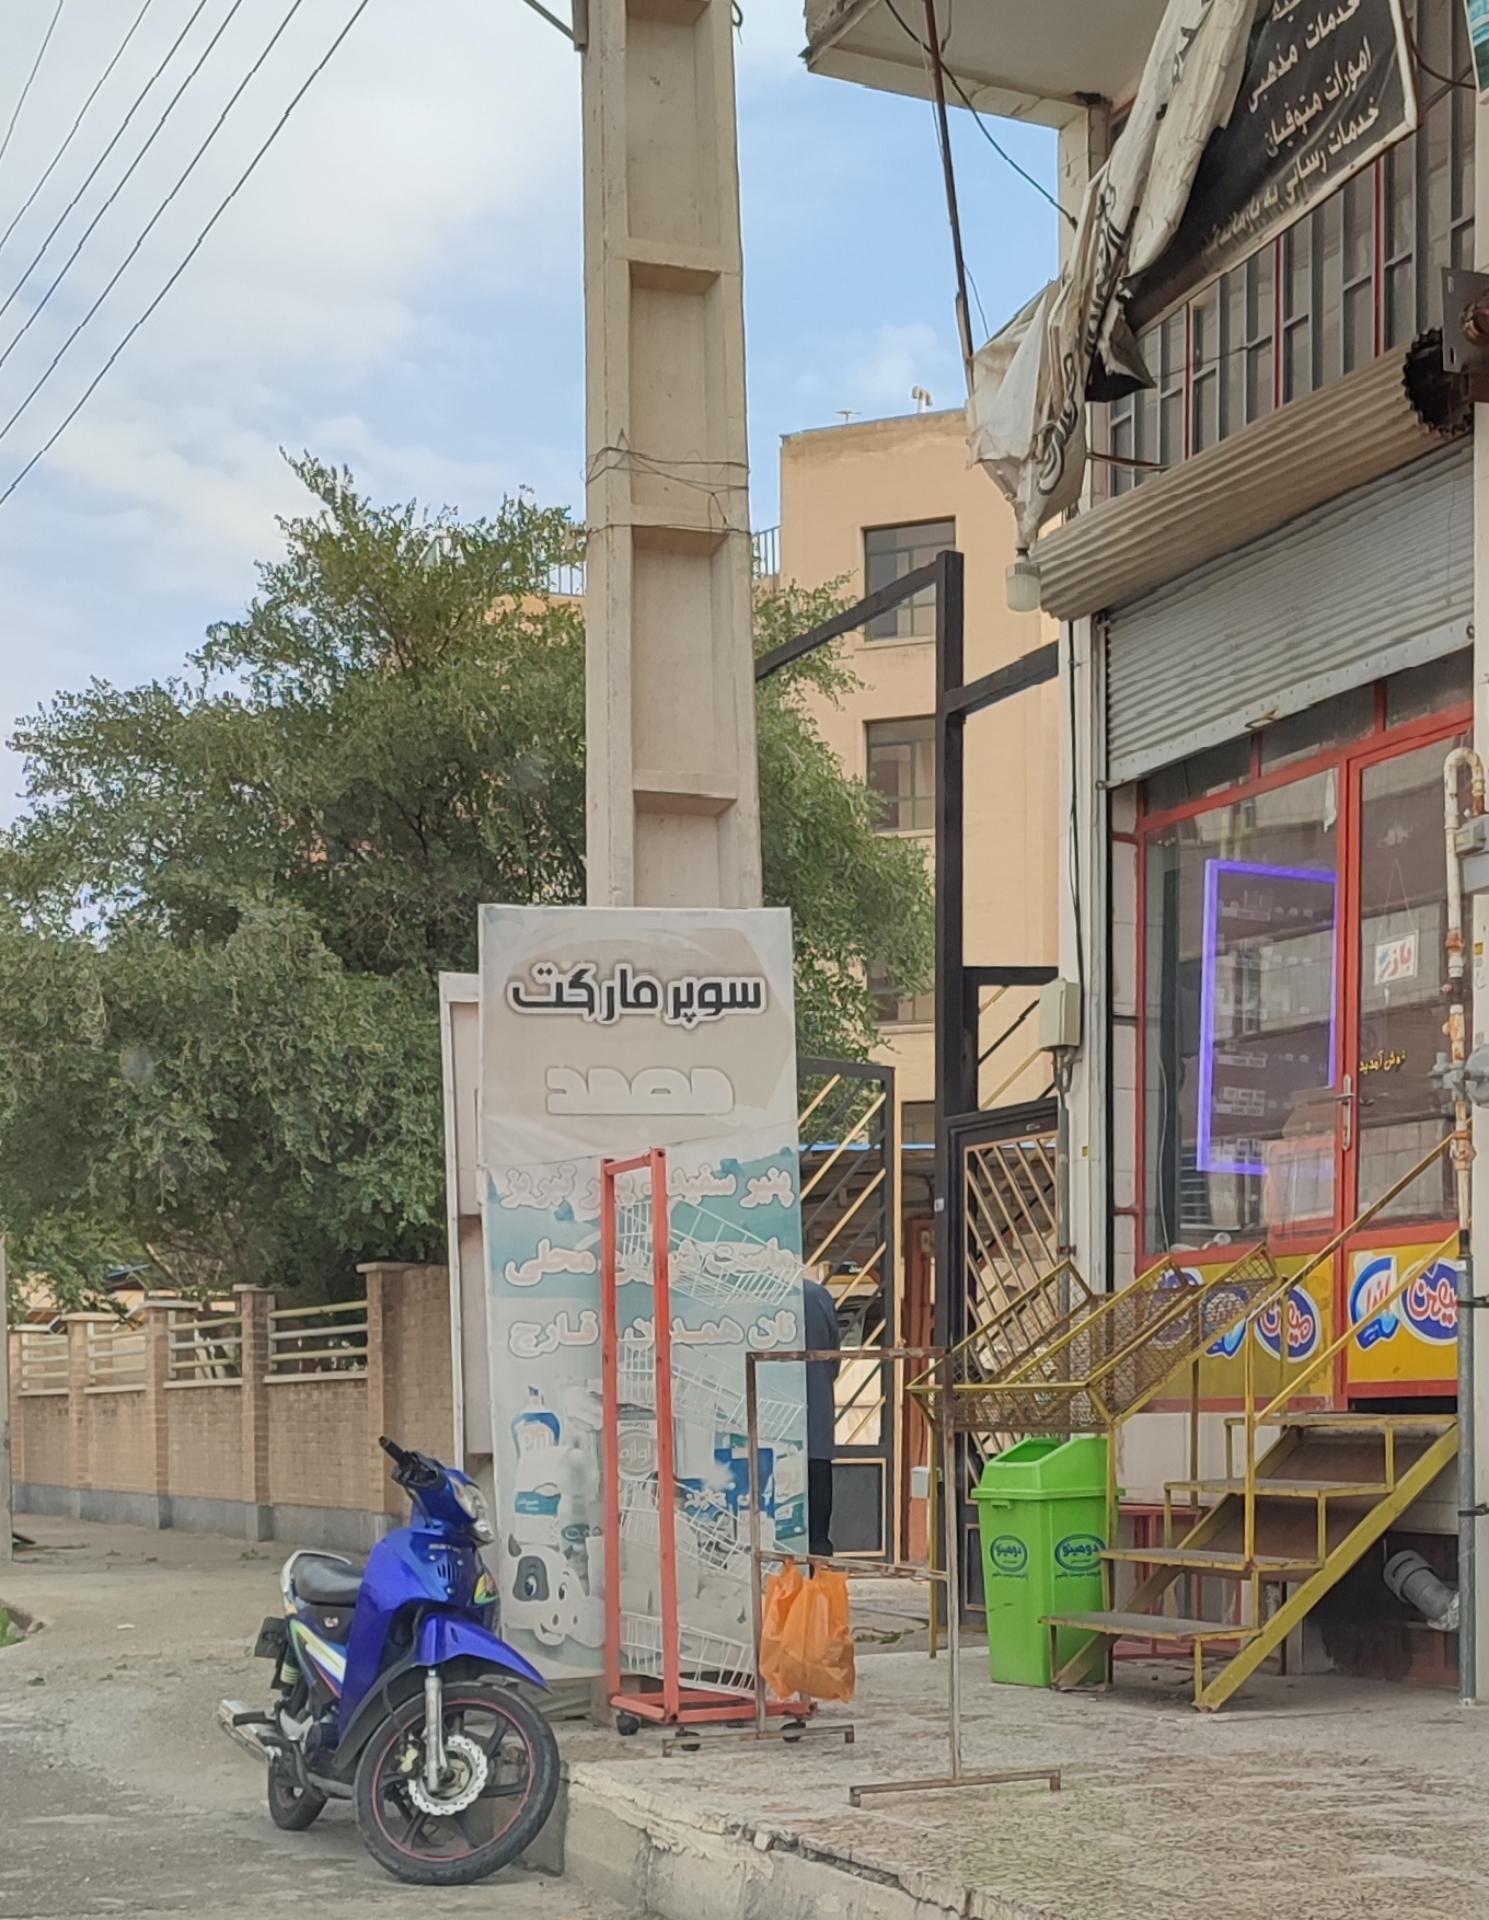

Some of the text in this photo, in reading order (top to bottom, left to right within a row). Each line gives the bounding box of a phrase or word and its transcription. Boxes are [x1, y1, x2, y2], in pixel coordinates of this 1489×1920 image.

[1248, 43, 1298, 114] مذهبی
[1328, 97, 1380, 156] خدمات
[511, 965, 765, 1027] سوپر مارکت
[505, 1237, 597, 1286] محلی
